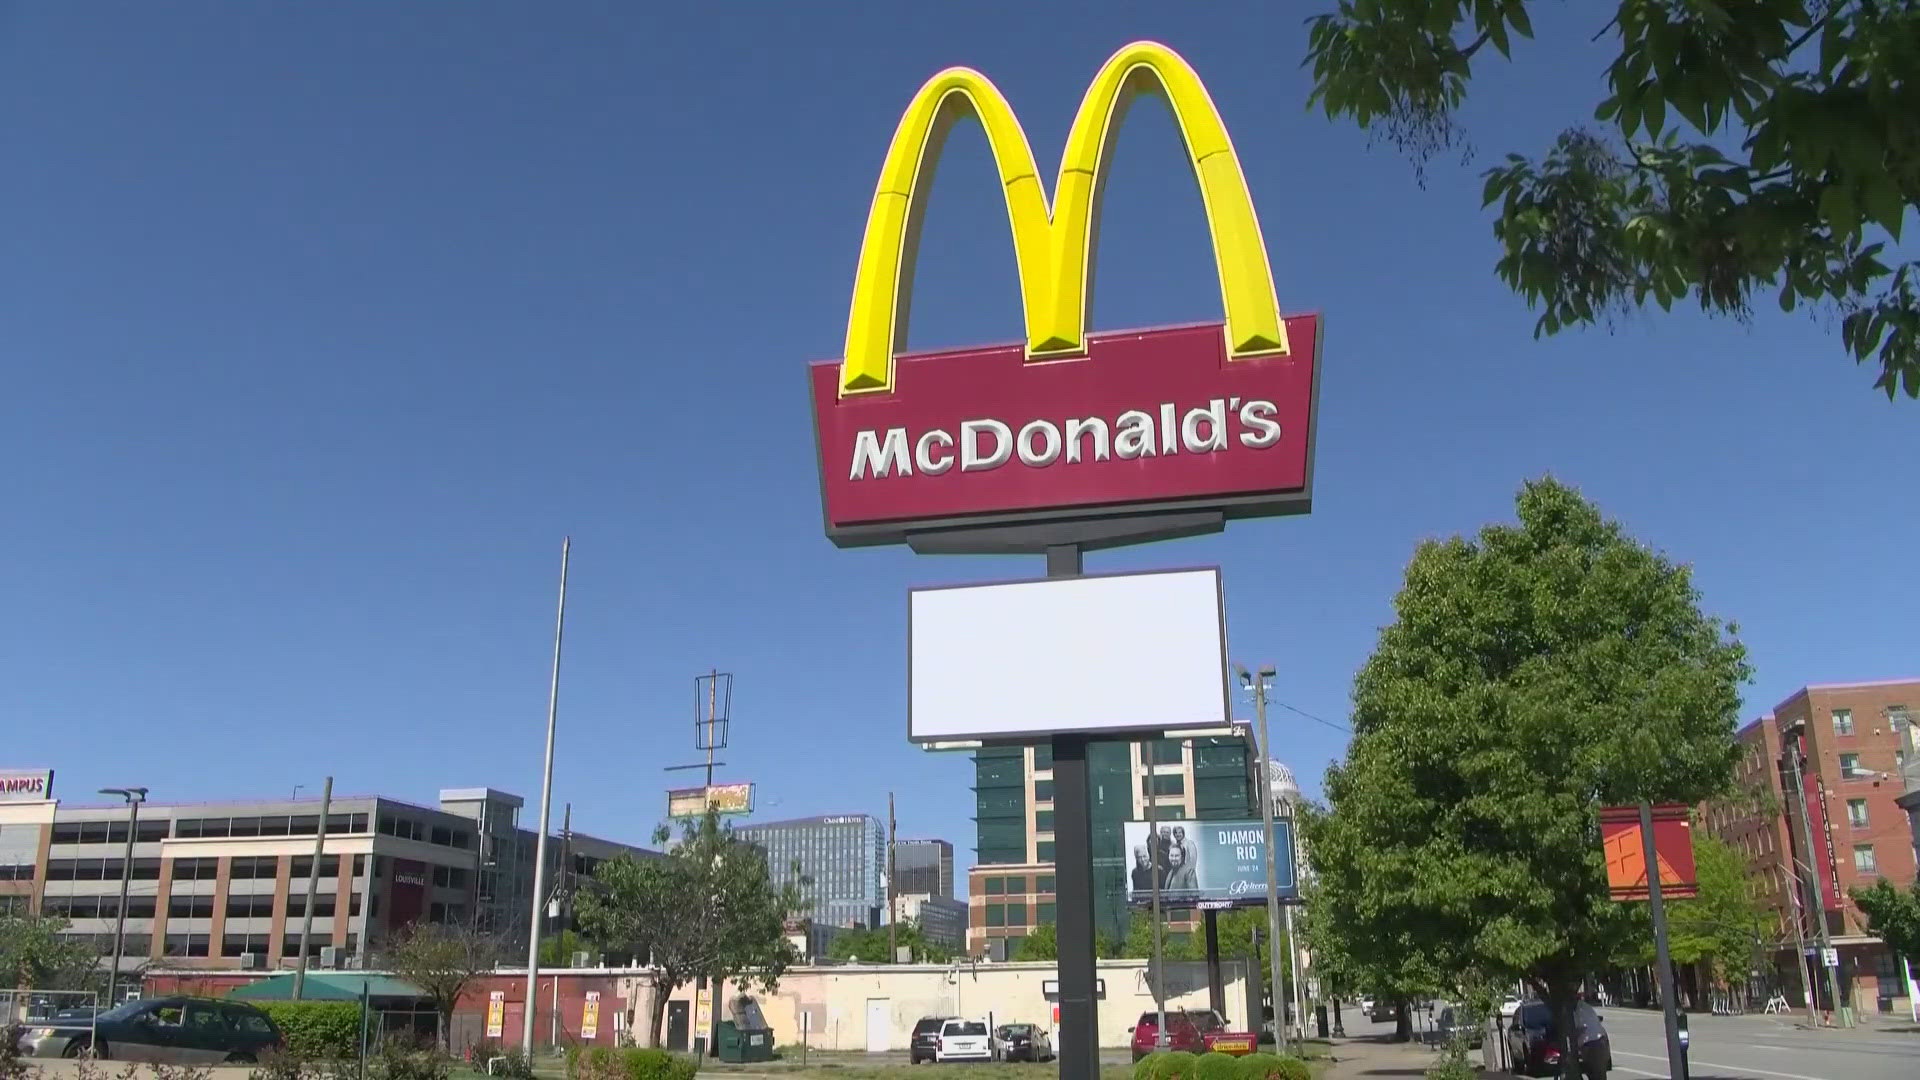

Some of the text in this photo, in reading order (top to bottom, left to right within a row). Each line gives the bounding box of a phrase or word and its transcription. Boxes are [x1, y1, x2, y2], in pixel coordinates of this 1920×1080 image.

[849, 396, 1282, 481] McDonald's
[1218, 829, 1265, 845] DIAMON
[1817, 782, 1840, 899] Residence Inn
[1236, 845, 1257, 860] RIO
[1229, 880, 1268, 895] Belterr
